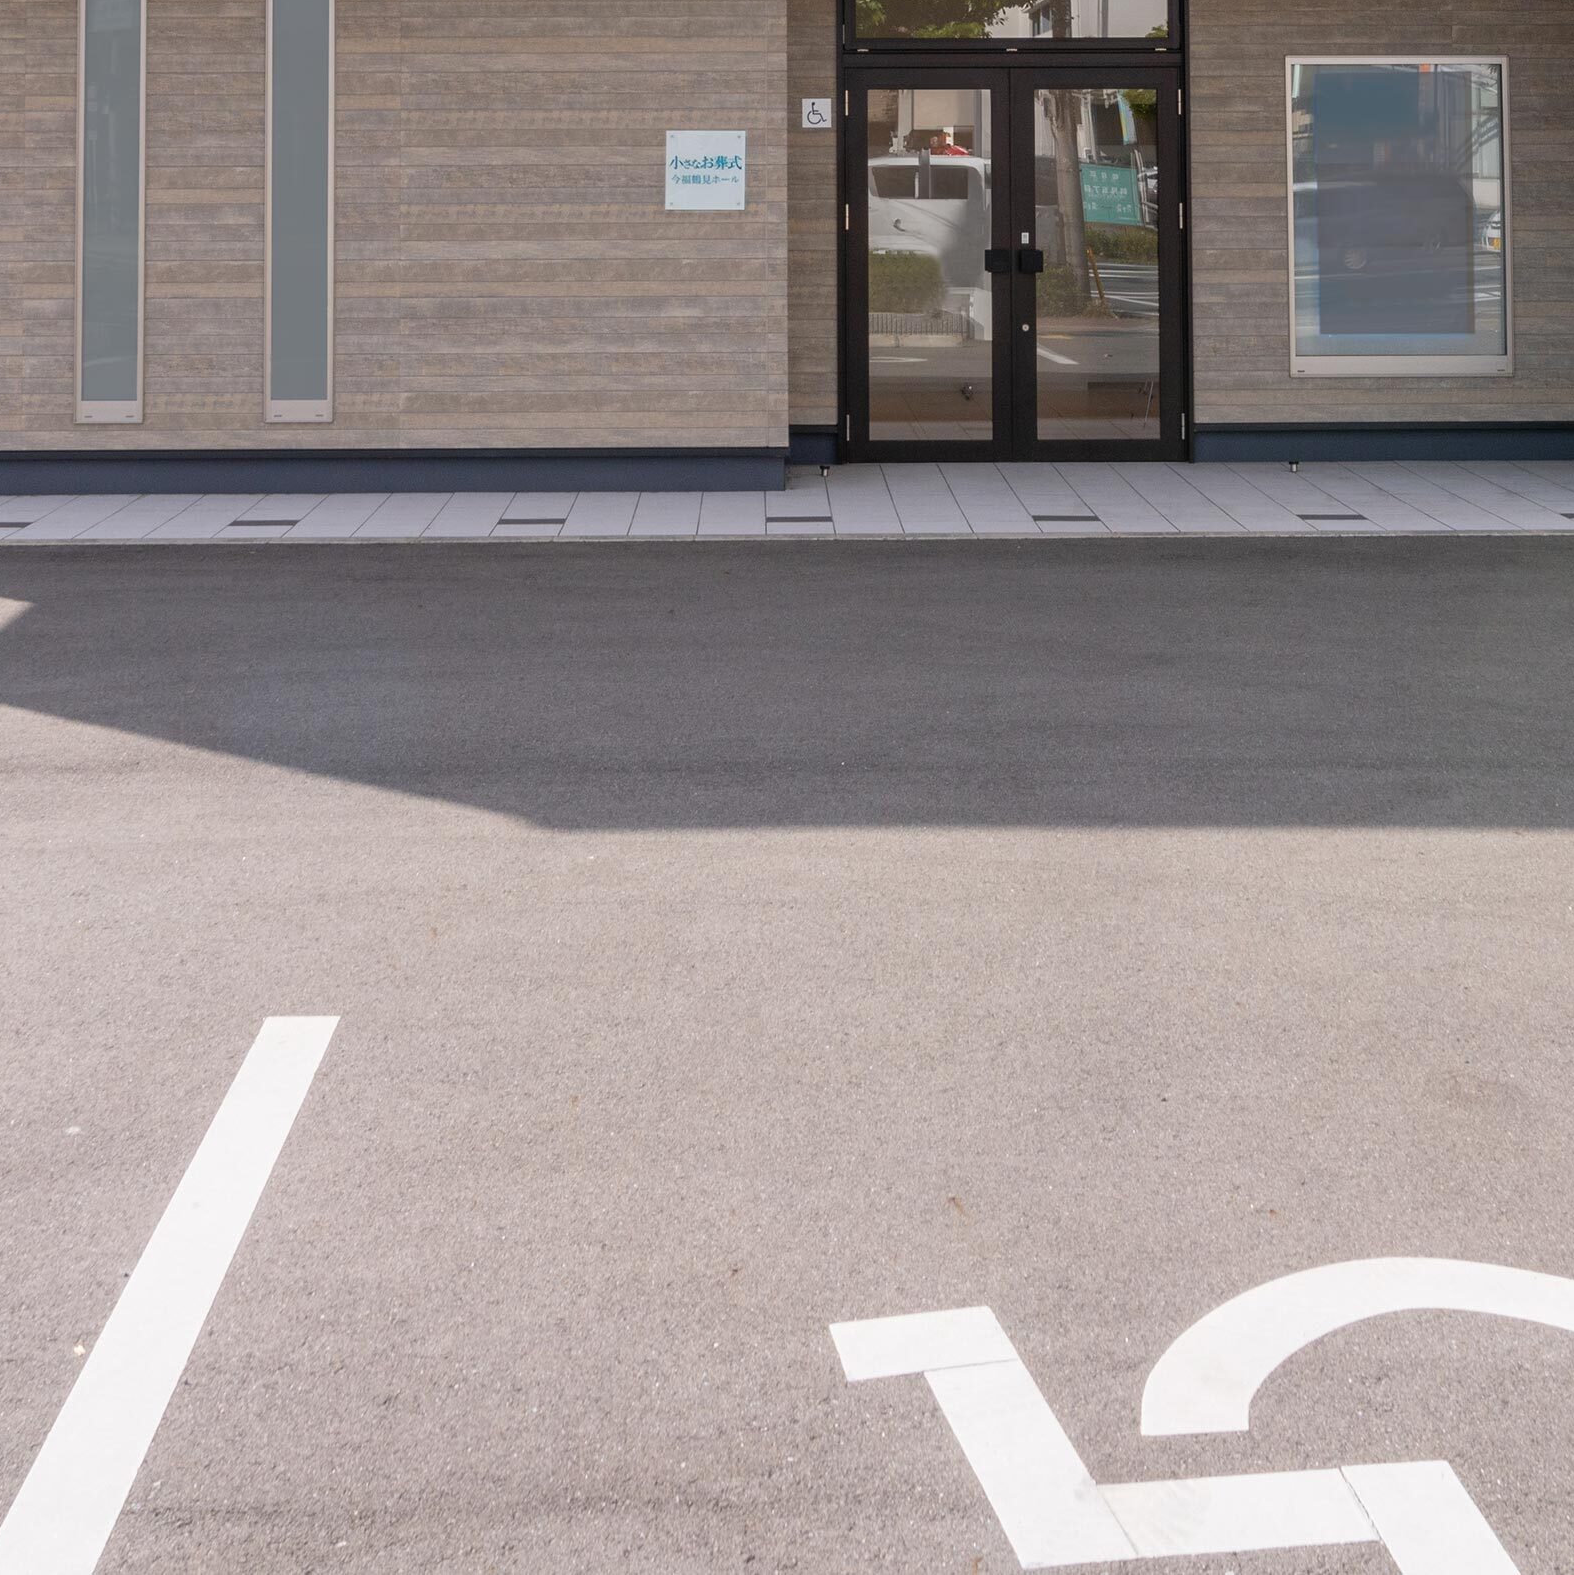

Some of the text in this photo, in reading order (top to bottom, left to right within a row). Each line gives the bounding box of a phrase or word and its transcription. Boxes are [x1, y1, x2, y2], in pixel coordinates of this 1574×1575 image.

[669, 155, 743, 170] 小さなお葬式
[671, 174, 740, 185] 今福鶴見ホール
